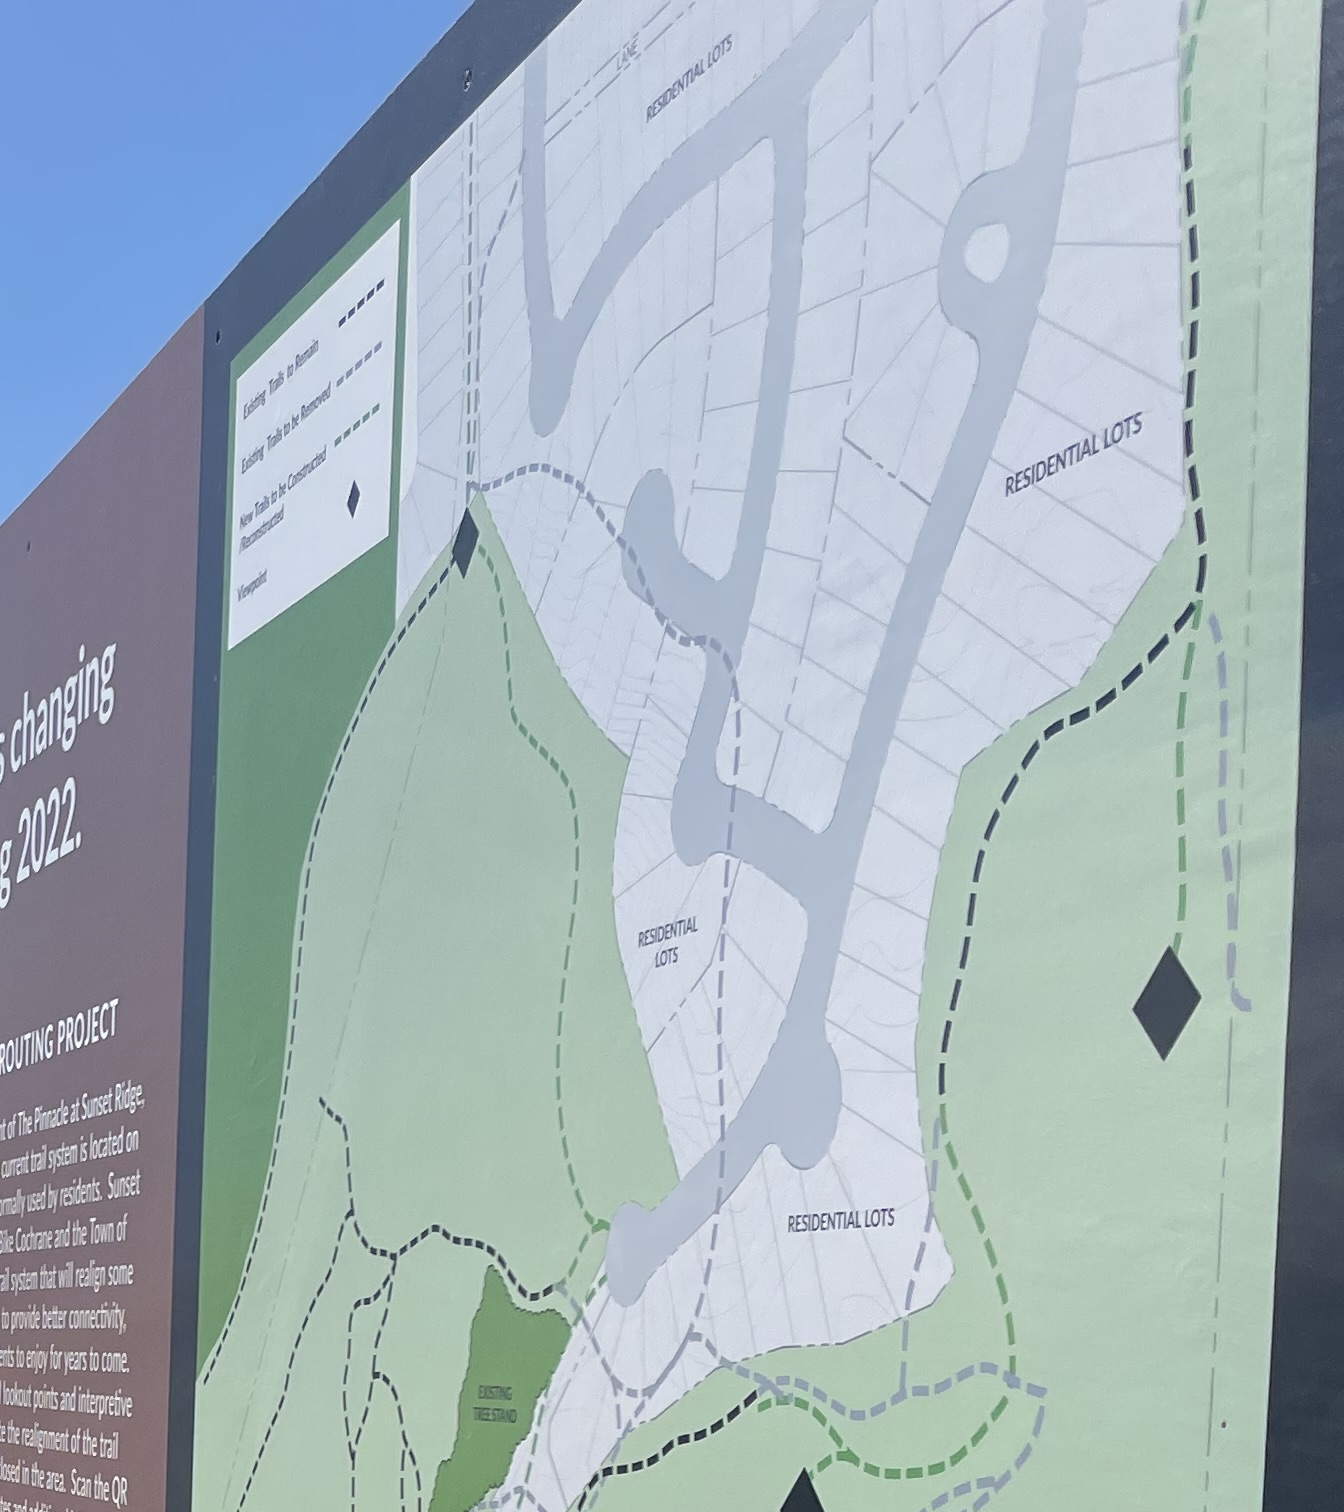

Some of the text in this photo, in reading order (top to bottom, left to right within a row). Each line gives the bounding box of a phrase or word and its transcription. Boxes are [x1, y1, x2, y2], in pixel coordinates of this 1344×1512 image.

[645, 33, 733, 124] RESIDENTIAL LOTS
[287, 363, 294, 379] to
[295, 338, 319, 371] Remain
[284, 421, 291, 437] to
[291, 413, 300, 431] be
[301, 380, 332, 421] Removed
[1004, 411, 1144, 498] RESIDENTIAL LOTS
[240, 444, 327, 531] New Trails to be Constructed
[238, 568, 268, 602] Viewpoint
[10, 642, 116, 772] changing
[16, 776, 81, 883] 2022.
[638, 916, 699, 948] RESIDENTIAL
[655, 946, 679, 969] LOTS
[56, 997, 118, 1055] PROJECT
[6, 1113, 16, 1139] of
[17, 1110, 32, 1136] The
[33, 1098, 68, 1132] Pinnacle
[69, 1097, 80, 1123] at
[81, 1087, 113, 1120] Sunset
[114, 1079, 144, 1113] Ridge,
[0, 1151, 29, 1178] current
[30, 1144, 46, 1172] trail
[47, 1141, 77, 1173] system
[79, 1135, 87, 1162] is
[89, 1125, 124, 1160] located
[125, 1130, 138, 1152] on
[26, 1183, 46, 1212] used
[47, 1182, 58, 1213] by
[59, 1176, 102, 1206] residents.
[107, 1168, 140, 1199] Sunset
[15, 1226, 52, 1252] Cochrane
[53, 1220, 70, 1248] and
[71, 1219, 87, 1246] the
[89, 1217, 114, 1244] Town
[116, 1212, 128, 1241] of
[787, 1208, 896, 1233] RESIDENTIAL LOTS
[10, 1267, 38, 1296] system
[39, 1264, 57, 1289] that
[57, 1260, 73, 1288] will
[74, 1259, 105, 1292] realign
[107, 1264, 133, 1285] some
[1, 1307, 9, 1329] to
[10, 1303, 40, 1334] provide
[41, 1303, 67, 1329] better
[68, 1301, 126, 1335] connectivity,
[15, 1345, 24, 1368] to
[25, 1343, 48, 1374] enjoy
[49, 1343, 62, 1369] for
[63, 1351, 87, 1375] years
[89, 1346, 99, 1371] to
[101, 1351, 129, 1373] come.
[2, 1380, 32, 1407] lookout
[32, 1383, 58, 1413] points
[59, 1385, 76, 1411] and
[77, 1385, 132, 1420] interpretive
[6, 1419, 20, 1444] the
[21, 1421, 69, 1454] realignment
[70, 1427, 81, 1453] of
[82, 1427, 97, 1456] the
[99, 1431, 118, 1459] trail
[21, 1459, 29, 1485] in
[31, 1461, 44, 1488] the
[45, 1470, 66, 1492] area.
[70, 1468, 91, 1497] Scan
[93, 1472, 109, 1501] the
[111, 1475, 127, 1509] QR
